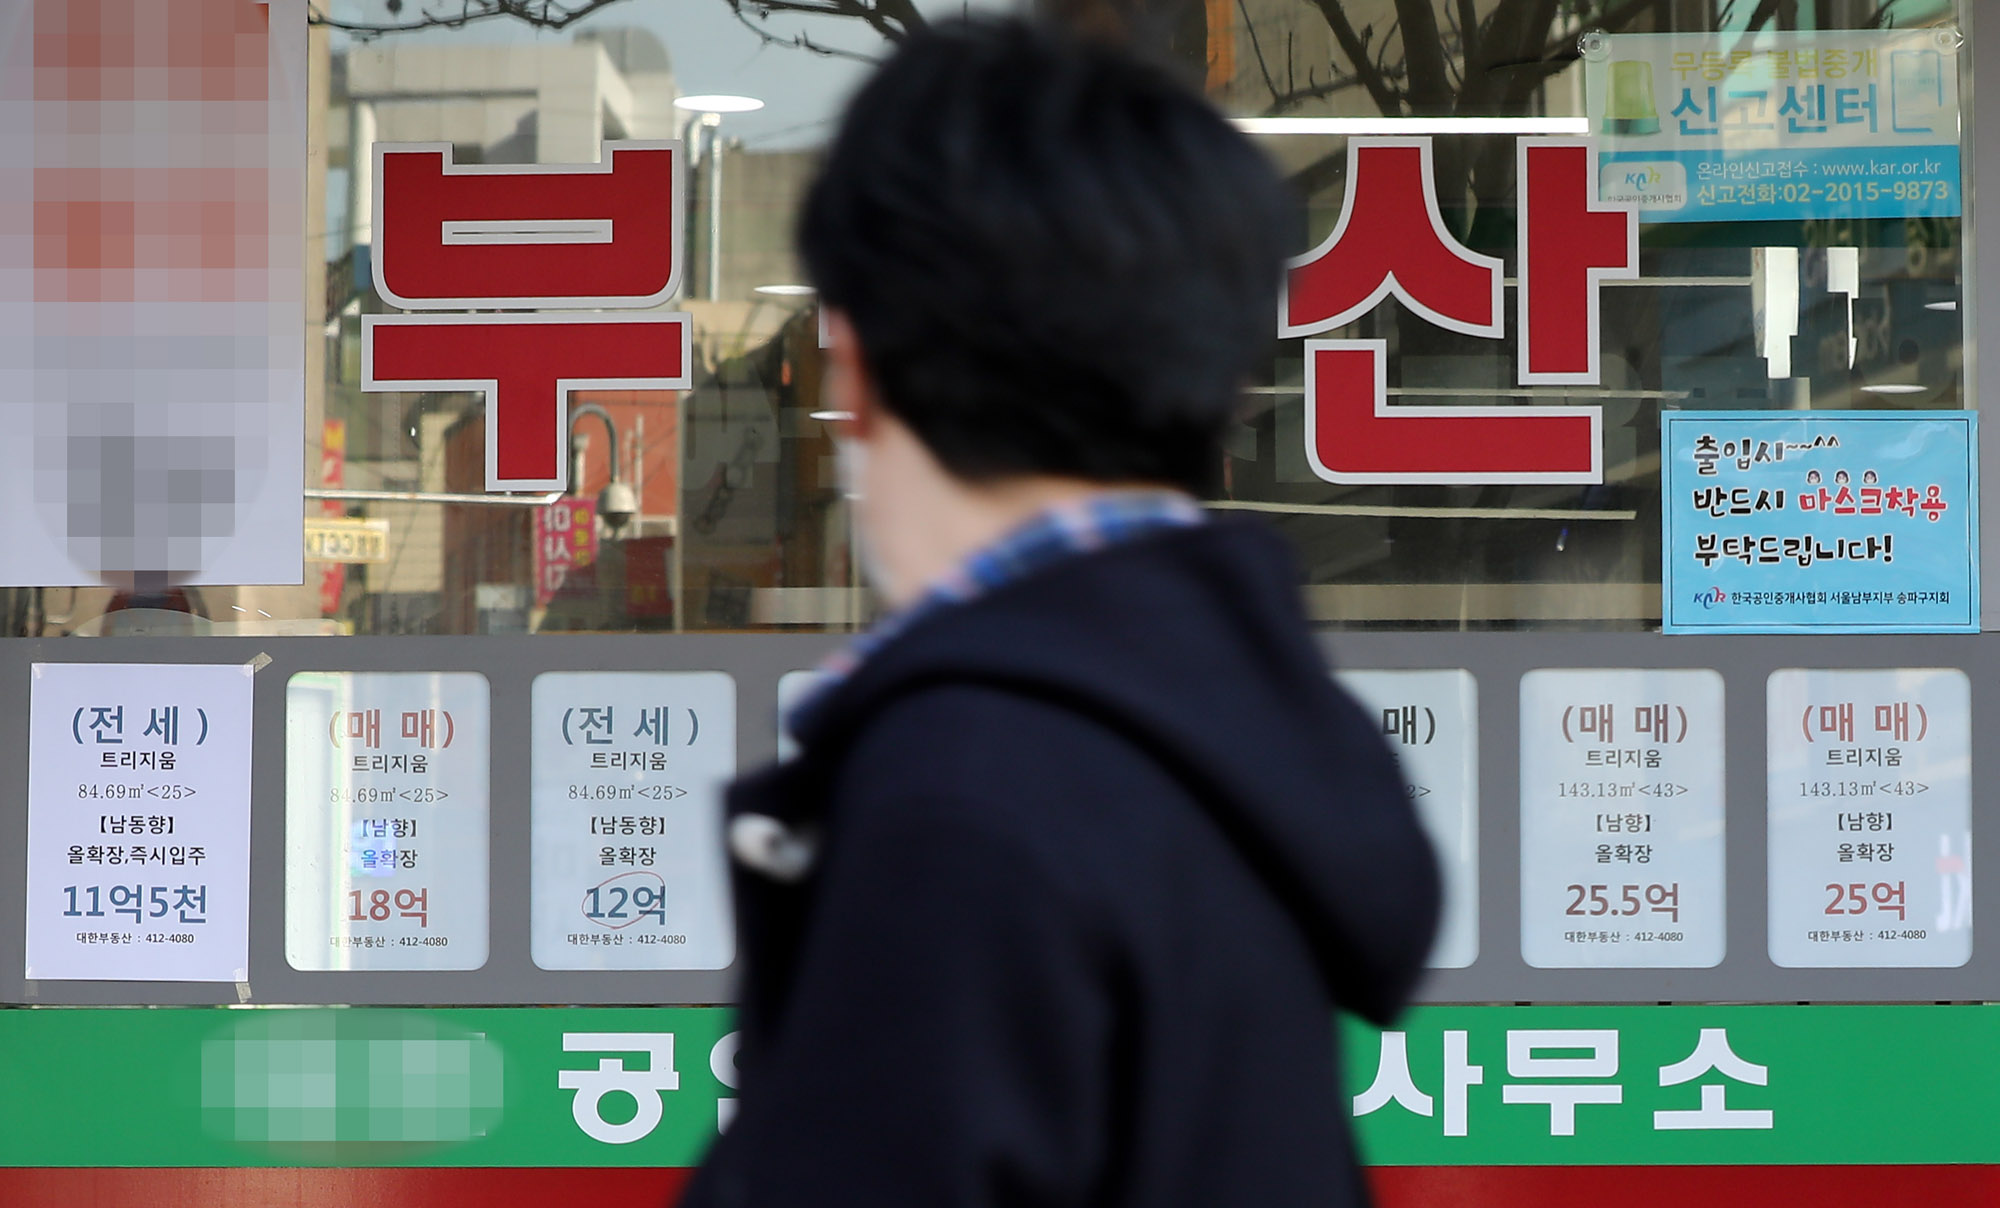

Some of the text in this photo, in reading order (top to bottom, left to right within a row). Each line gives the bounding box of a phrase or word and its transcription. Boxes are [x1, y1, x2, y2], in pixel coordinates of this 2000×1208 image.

[1670, 49, 1878, 80] 무등록 불법중개
[1671, 83, 1878, 136] 신고센터
[1696, 161, 1809, 179] 온라인신고접수
[1823, 160, 1941, 178] www.kar.or.kr
[362, 136, 1640, 491] 부 산
[1693, 486, 1947, 522] 반드시 마스크착용
[1693, 534, 1893, 567] 부탁드립니다!
[1732, 591, 1827, 605] 한국공인중개사협회
[1831, 591, 1893, 605] 서울남부지부
[1897, 591, 1949, 605] 송파구지회
[100, 751, 176, 770] 트리지움
[352, 754, 428, 773] 트리지움
[590, 750, 667, 773] 트리지움
[1585, 749, 1662, 768] 트리지움
[1826, 744, 1902, 768] 트리지움
[67, 845, 206, 866] 올확장,즉시입주
[361, 846, 418, 868] 올확장
[599, 843, 659, 868] 올확장
[1595, 844, 1653, 864] 올확장
[1837, 841, 1896, 865] 올확장
[64, 884, 206, 924] 11억5천
[348, 887, 429, 927] 18억
[584, 884, 666, 927] 12억
[1565, 880, 1680, 923] 25.5억
[1824, 879, 1909, 922] 25억
[74, 930, 132, 944] 대한부동산
[145, 933, 194, 944] 412-4080
[328, 935, 387, 949] 대한부동산
[398, 936, 450, 948] 412-4080
[565, 933, 624, 947] 대한부동산
[636, 934, 688, 946] 412-4080
[1562, 930, 1621, 944] 대한부동산
[1632, 930, 1685, 943] 412-4080
[1805, 928, 1865, 942] 대한부동산
[1877, 928, 1929, 941] 412-4080
[1353, 1029, 1774, 1136] 사무소
